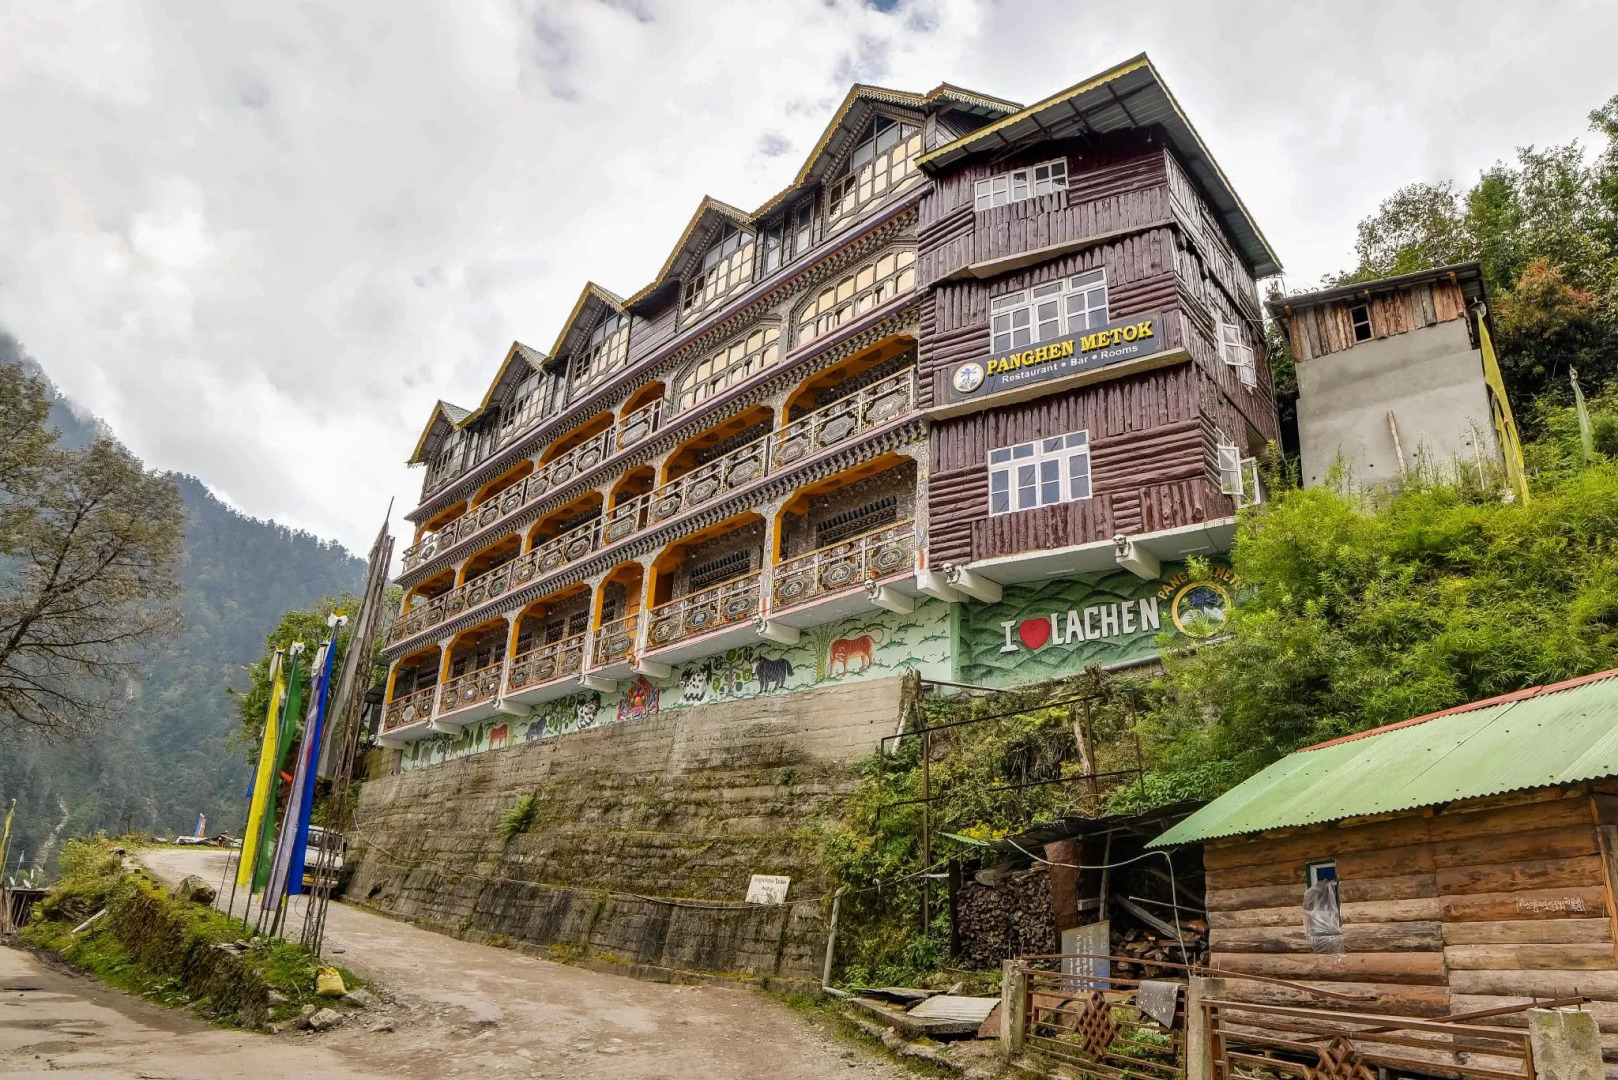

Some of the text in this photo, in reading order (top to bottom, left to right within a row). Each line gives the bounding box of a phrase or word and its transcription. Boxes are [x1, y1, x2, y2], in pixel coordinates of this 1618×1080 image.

[987, 320, 1154, 375] PANGHEN METOK
[1002, 344, 1139, 384] Restaurant Bar Rooms
[1000, 597, 1161, 653] I LACHEN
